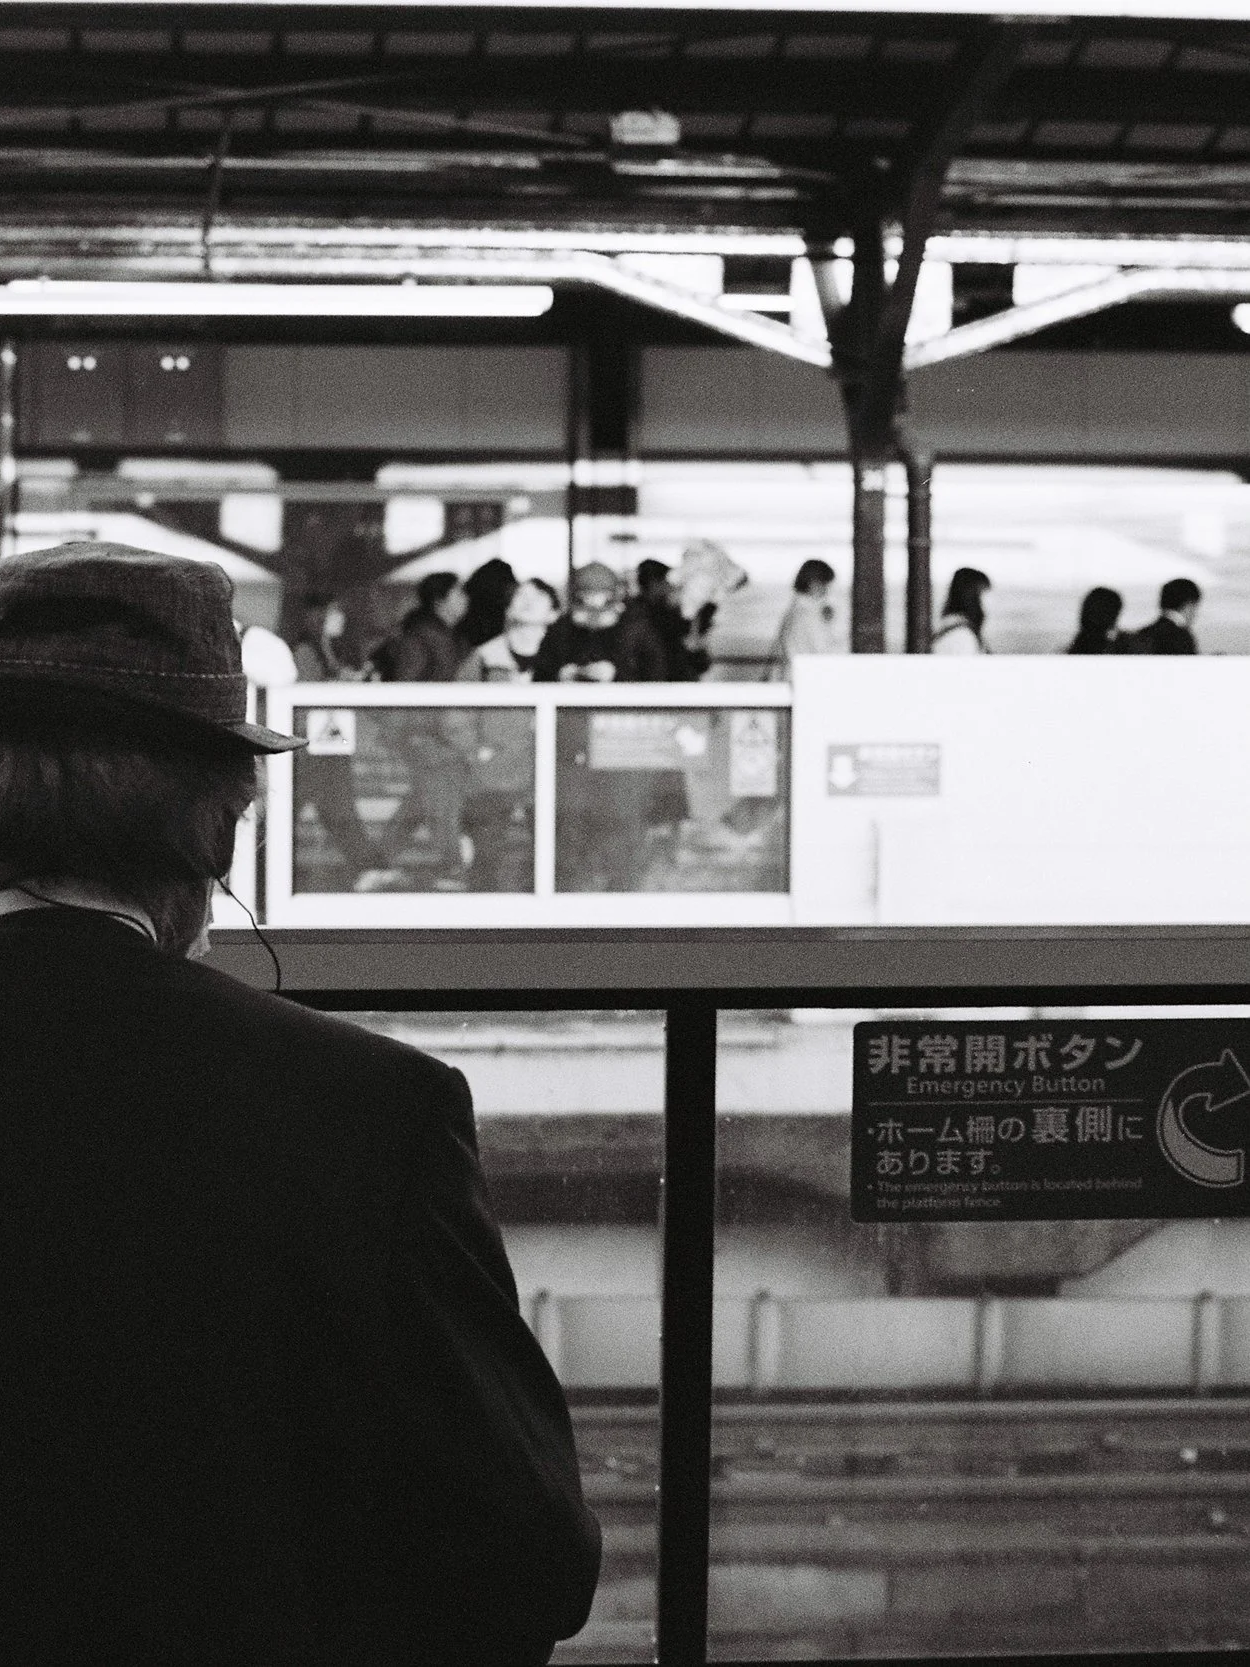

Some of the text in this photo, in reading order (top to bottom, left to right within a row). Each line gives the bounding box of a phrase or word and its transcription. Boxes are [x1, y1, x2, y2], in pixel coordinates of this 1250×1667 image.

[867, 1033, 1144, 1074] 非常開ボタン
[906, 1075, 1106, 1099] Emergency Button
[875, 1148, 1002, 1176] あります。
[981, 1179, 1028, 1191] button
[1043, 1178, 1092, 1190] located
